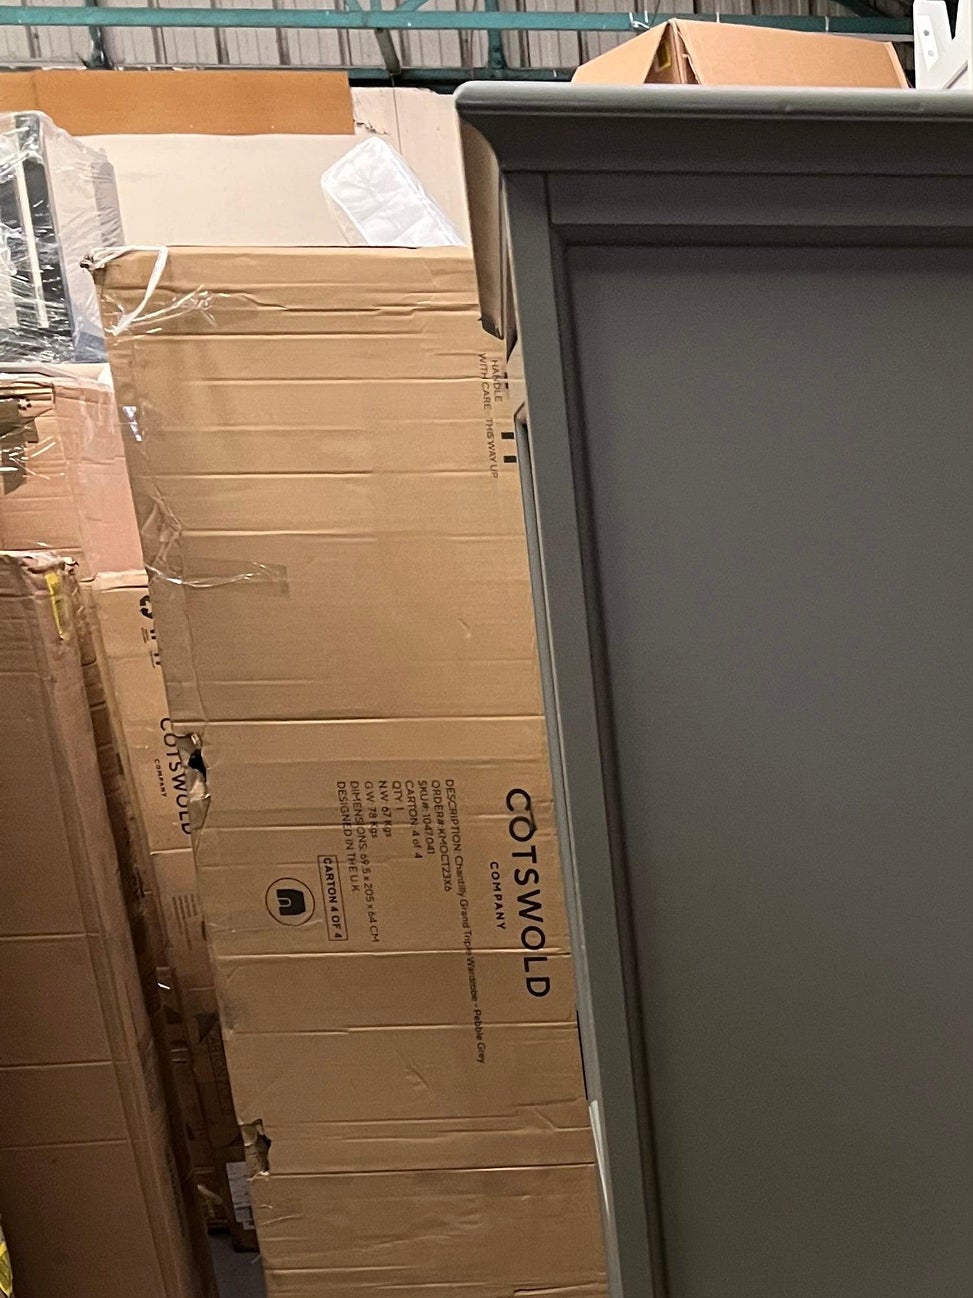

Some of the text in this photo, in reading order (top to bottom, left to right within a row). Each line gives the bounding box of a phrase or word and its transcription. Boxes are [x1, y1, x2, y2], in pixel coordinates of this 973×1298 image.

[479, 353, 492, 410] WITH CARE
[492, 359, 502, 402] HANDLE
[486, 418, 498, 478] THIS WAY UP
[154, 759, 167, 798] COMPANY
[160, 718, 191, 835] COTSWOLD
[337, 781, 353, 836] DESIGNED
[368, 807, 377, 819] 78
[381, 806, 391, 817] 67
[368, 821, 378, 839] Kgs
[382, 820, 392, 838] Kgs
[413, 839, 422, 849] of
[345, 839, 354, 850] IN
[347, 853, 358, 872] THE
[454, 855, 466, 897] Chantilly
[323, 857, 338, 904] CARTON
[331, 915, 342, 931] OF
[364, 883, 375, 902] 205
[489, 861, 506, 931] COMPANY
[505, 788, 551, 998] COTSWOLD
[368, 911, 378, 923] 64
[459, 898, 470, 928] Grand
[370, 926, 379, 943] CM
[466, 957, 478, 1002] Wardrobe
[472, 1009, 483, 1040] Pebble
[476, 1042, 486, 1064] Grey
